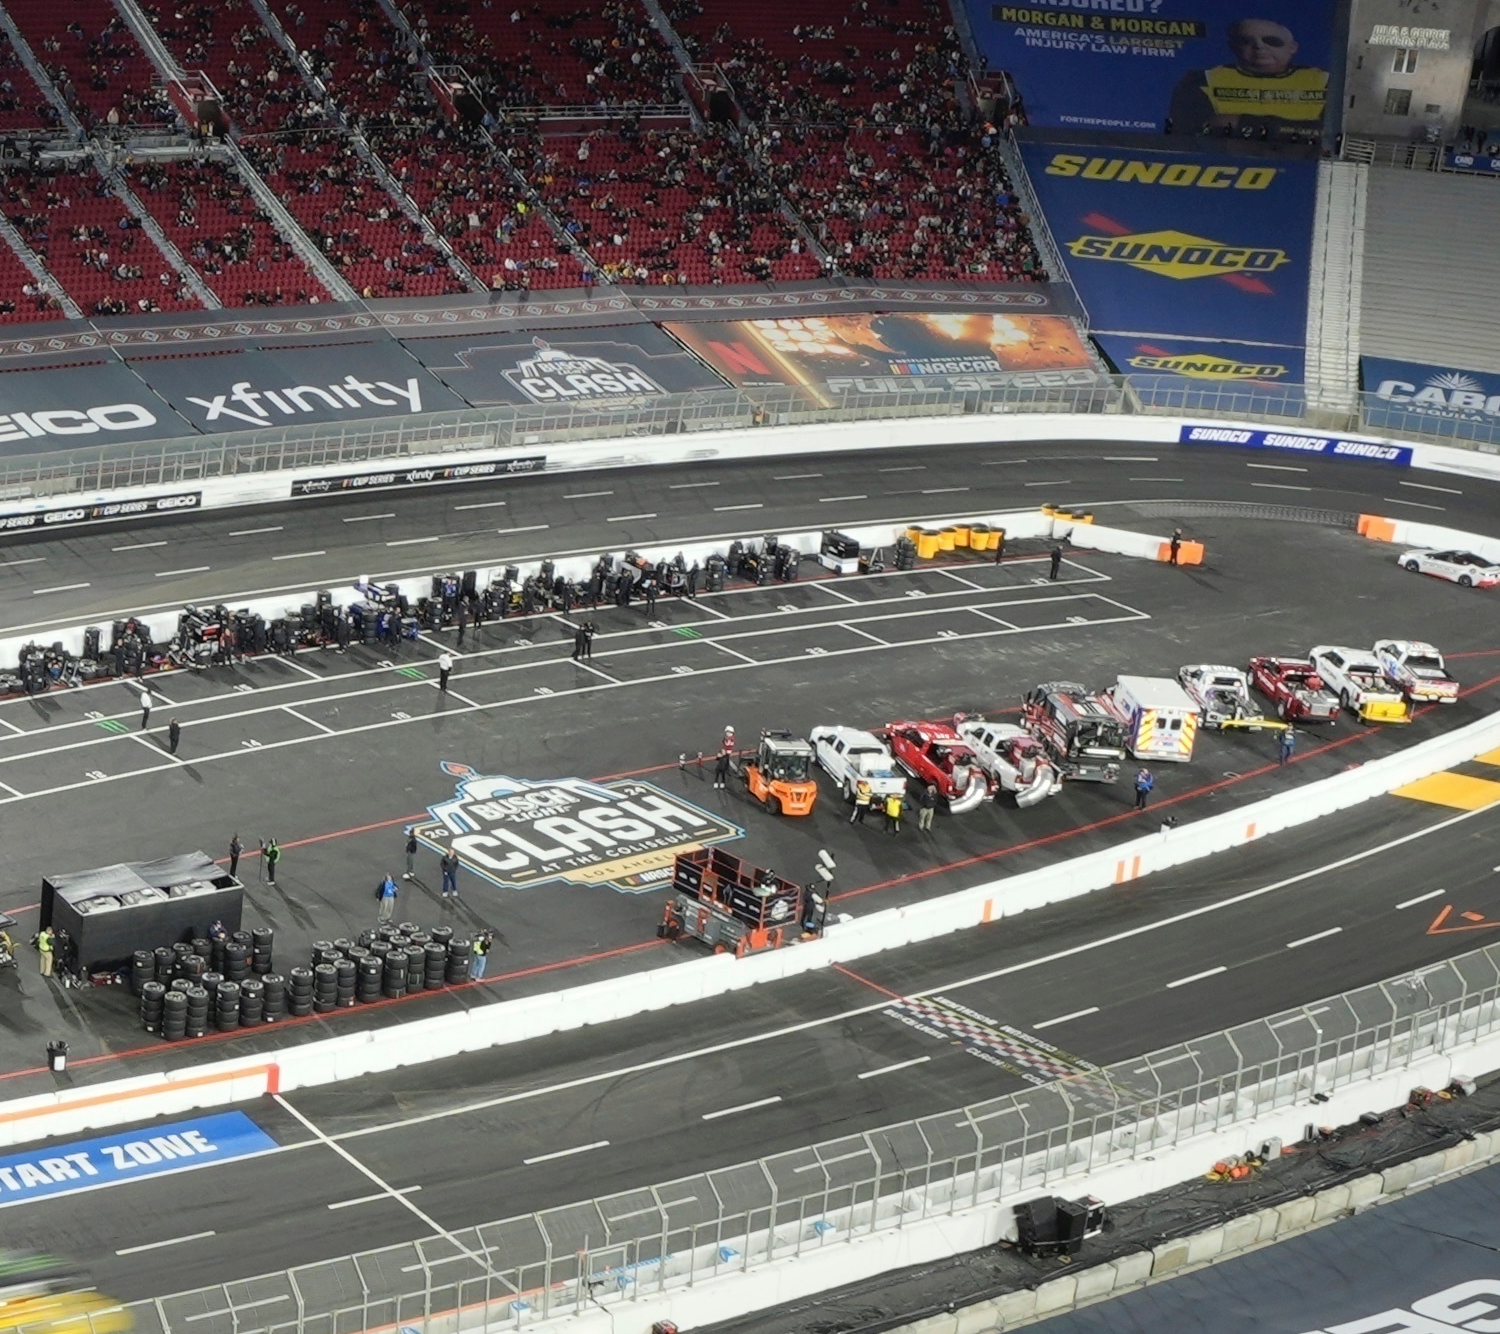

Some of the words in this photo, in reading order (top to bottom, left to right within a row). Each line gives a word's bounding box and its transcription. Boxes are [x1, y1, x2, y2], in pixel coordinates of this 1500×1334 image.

[1001, 7, 1084, 30] MORGAN
[1090, 16, 1105, 31] &
[1111, 17, 1197, 38] MORGAN
[1014, 27, 1106, 45] AMERICA'S
[1108, 35, 1185, 50] LARGEST
[1025, 37, 1088, 53] INJURY
[1090, 41, 1129, 55] LAW
[1132, 44, 1175, 58] FIRM
[1060, 114, 1156, 131] FORTHEPEOPLE.COM
[1045, 153, 1278, 190] SUNOCO
[1075, 237, 1276, 270] SUNOCO
[919, 358, 1003, 375] NASCAR
[1131, 355, 1283, 379] SUNOCO
[519, 371, 656, 399] CLASH
[826, 375, 950, 395] FULL
[947, 368, 1099, 394] SPEED
[186, 374, 422, 428] xfinity
[1407, 406, 1483, 423] TEQUILA
[1189, 427, 1254, 445] SUNOCO
[1262, 433, 1328, 452] SUNOCO
[1333, 440, 1400, 460] SUNOCO
[85, 770, 106, 780] 12
[625, 786, 647, 797] 24
[466, 787, 580, 821] BUSCH
[513, 806, 565, 824] LIGHT
[424, 828, 449, 841] 20
[450, 794, 708, 871] CLASH
[541, 863, 562, 874] AT
[567, 852, 602, 870] THE
[609, 831, 692, 858] COLISEUM
[111, 1129, 219, 1170] ZONE
